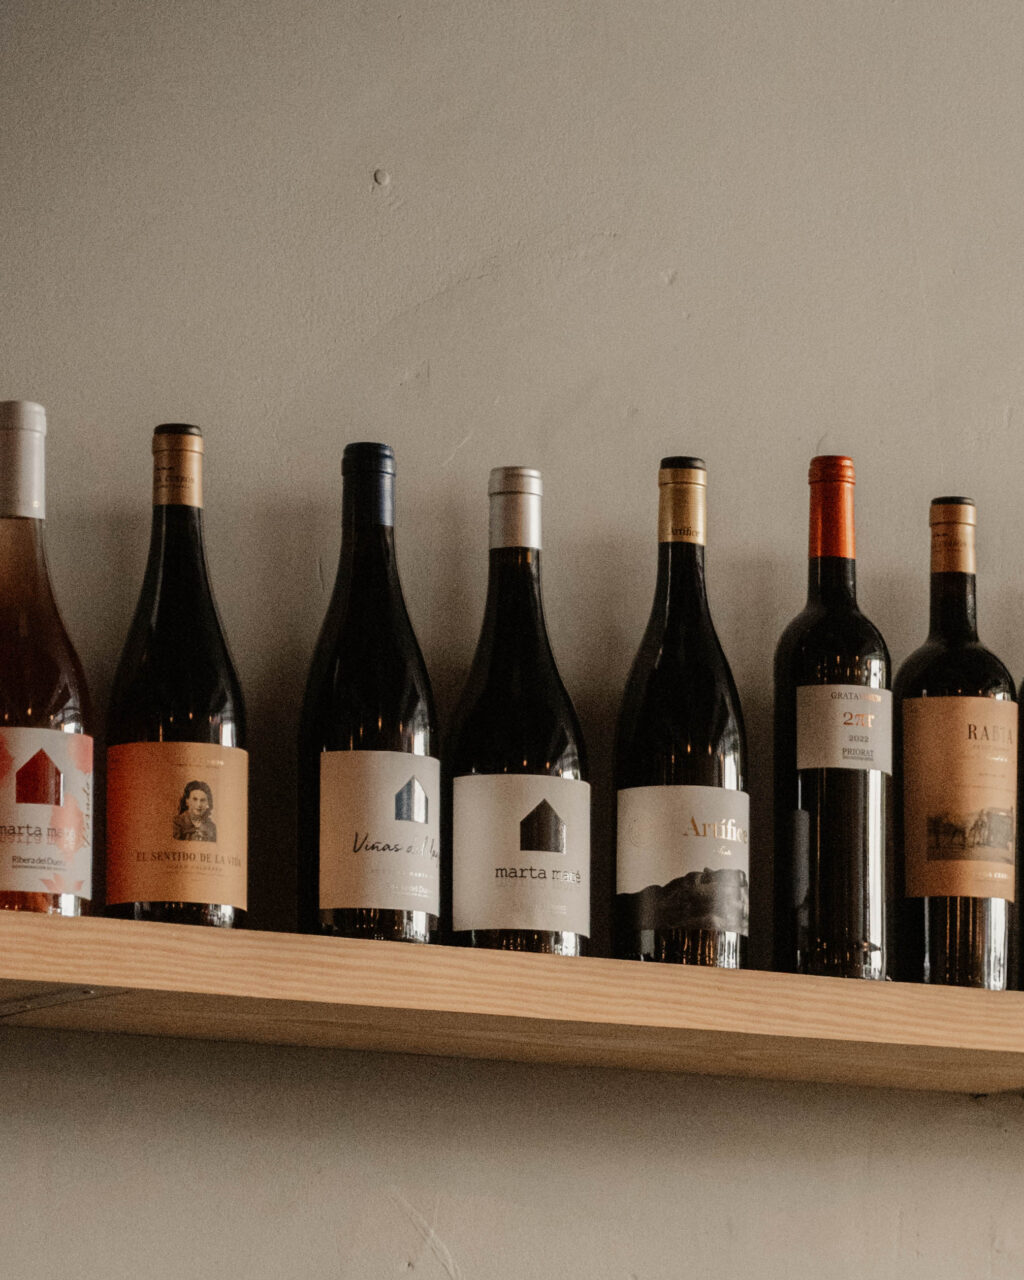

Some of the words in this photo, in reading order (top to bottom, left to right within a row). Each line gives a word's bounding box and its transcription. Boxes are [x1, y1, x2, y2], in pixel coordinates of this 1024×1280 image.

[842, 747, 874, 757] PRIORAT
[352, 831, 401, 853] Viñas
[151, 851, 197, 862] SENTIDO
[200, 852, 211, 863] DE
[495, 865, 547, 879] marta
